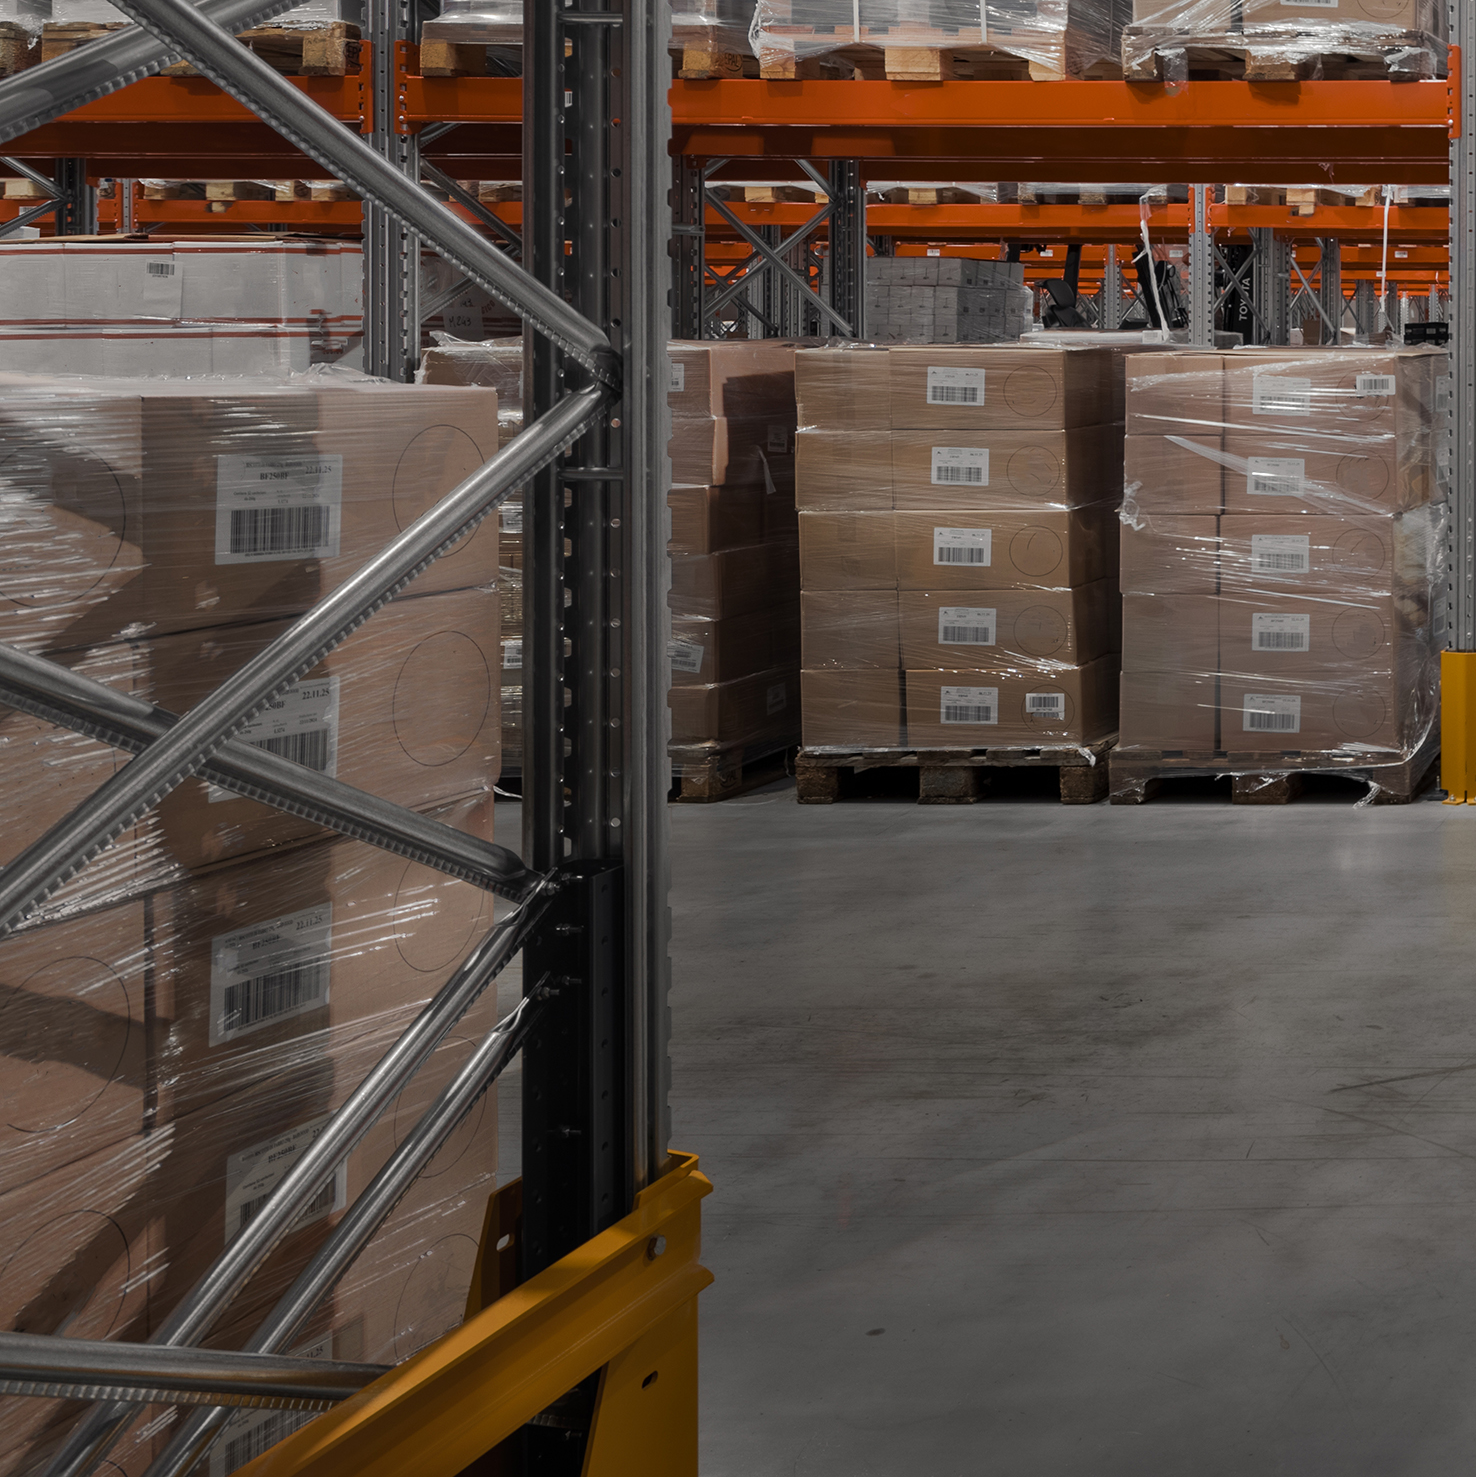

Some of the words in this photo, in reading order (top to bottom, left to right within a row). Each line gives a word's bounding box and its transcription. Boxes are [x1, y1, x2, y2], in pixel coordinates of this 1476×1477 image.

[305, 465, 332, 475] 22.11.25
[302, 688, 330, 700] 22.11.25
[296, 915, 323, 930] 22.11.25
